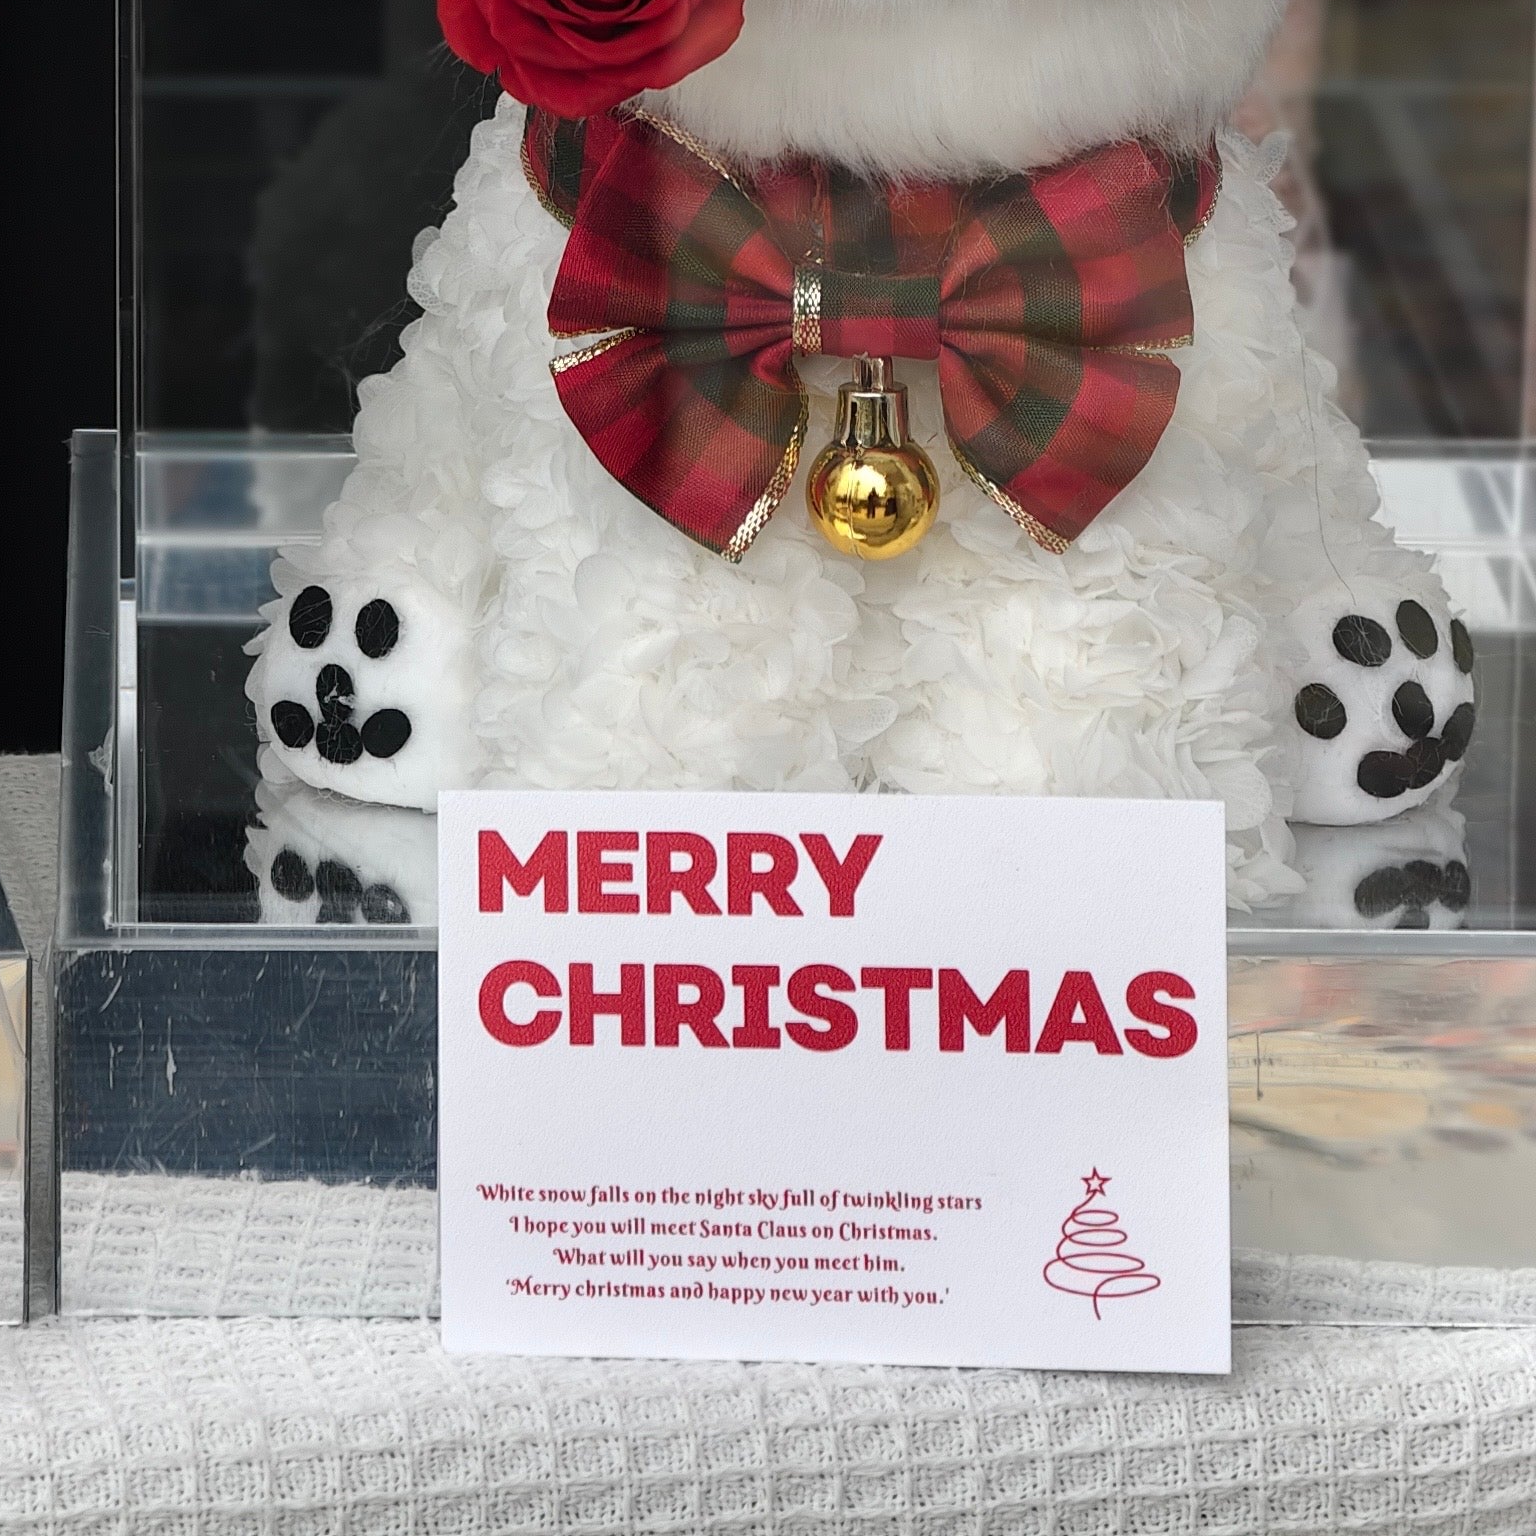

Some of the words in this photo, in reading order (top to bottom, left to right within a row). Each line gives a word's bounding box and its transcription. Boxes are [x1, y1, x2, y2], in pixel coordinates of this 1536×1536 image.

[478, 830, 882, 917] MERRY
[478, 960, 1198, 1058] CHRISTMAS
[476, 1184, 534, 1202] White
[539, 1190, 586, 1203] snow
[587, 1185, 629, 1207] falls
[635, 1191, 656, 1205] on
[662, 1187, 689, 1205] the
[695, 1188, 745, 1209] night
[749, 1189, 780, 1210] sky
[780, 1189, 814, 1210] full
[820, 1190, 840, 1211] of
[843, 1191, 933, 1214] twinkling
[938, 1195, 982, 1210] stars
[509, 1216, 518, 1232] I
[524, 1216, 568, 1238] hope
[571, 1222, 606, 1238] you
[611, 1217, 645, 1234] will
[651, 1221, 696, 1235] meet
[700, 1219, 752, 1238] Santa
[757, 1220, 807, 1239] Claus
[812, 1226, 833, 1240] on
[839, 1222, 937, 1241] Christmas.
[553, 1248, 606, 1266] What
[610, 1249, 644, 1266] will
[648, 1254, 682, 1271] you
[688, 1255, 717, 1272] say
[722, 1251, 771, 1270] when
[774, 1257, 809, 1273] you
[814, 1256, 860, 1270] meet
[864, 1253, 904, 1272] him.
[576, 1280, 665, 1298] christmas
[670, 1282, 703, 1300] and
[708, 1282, 765, 1305] happy
[770, 1289, 807, 1302] new
[810, 1289, 853, 1306] year
[857, 1286, 899, 1304] with
